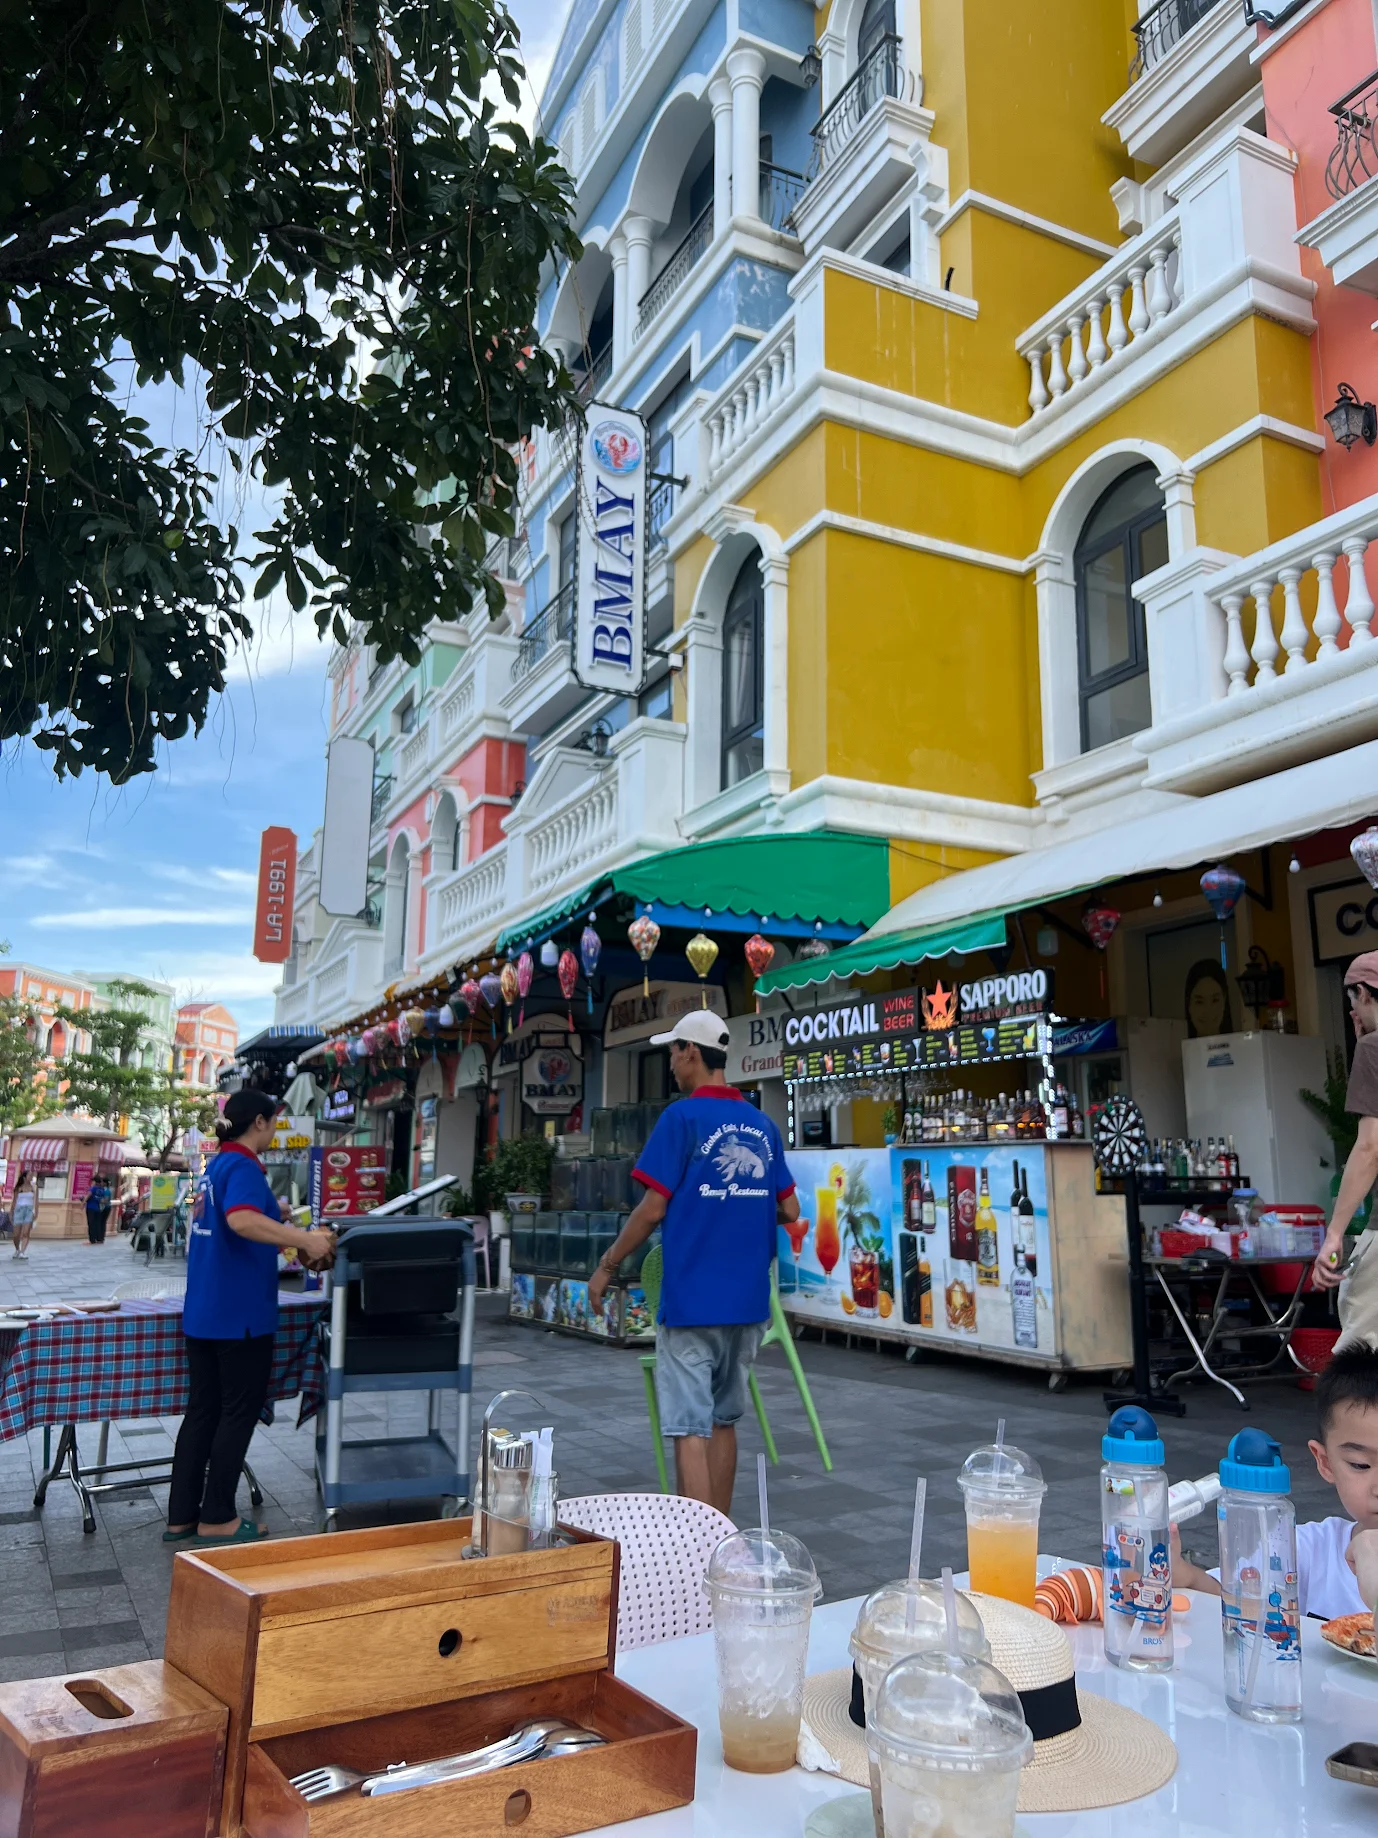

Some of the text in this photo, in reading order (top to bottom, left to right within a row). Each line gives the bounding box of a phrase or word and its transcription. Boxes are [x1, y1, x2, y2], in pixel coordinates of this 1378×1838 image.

[591, 476, 635, 671] BMAY
[265, 858, 287, 942] LA-1991
[883, 993, 914, 1013] WINE
[960, 968, 1047, 1013] SAPPORO
[1015, 1001, 1043, 1016] BEER
[785, 1002, 880, 1046] COCKTAIL
[883, 1012, 915, 1032] BEER
[525, 1083, 582, 1097] BMAY
[700, 1127, 722, 1155] Global
[739, 1123, 764, 1139] Local
[1142, 1637, 1164, 1646] BROS
